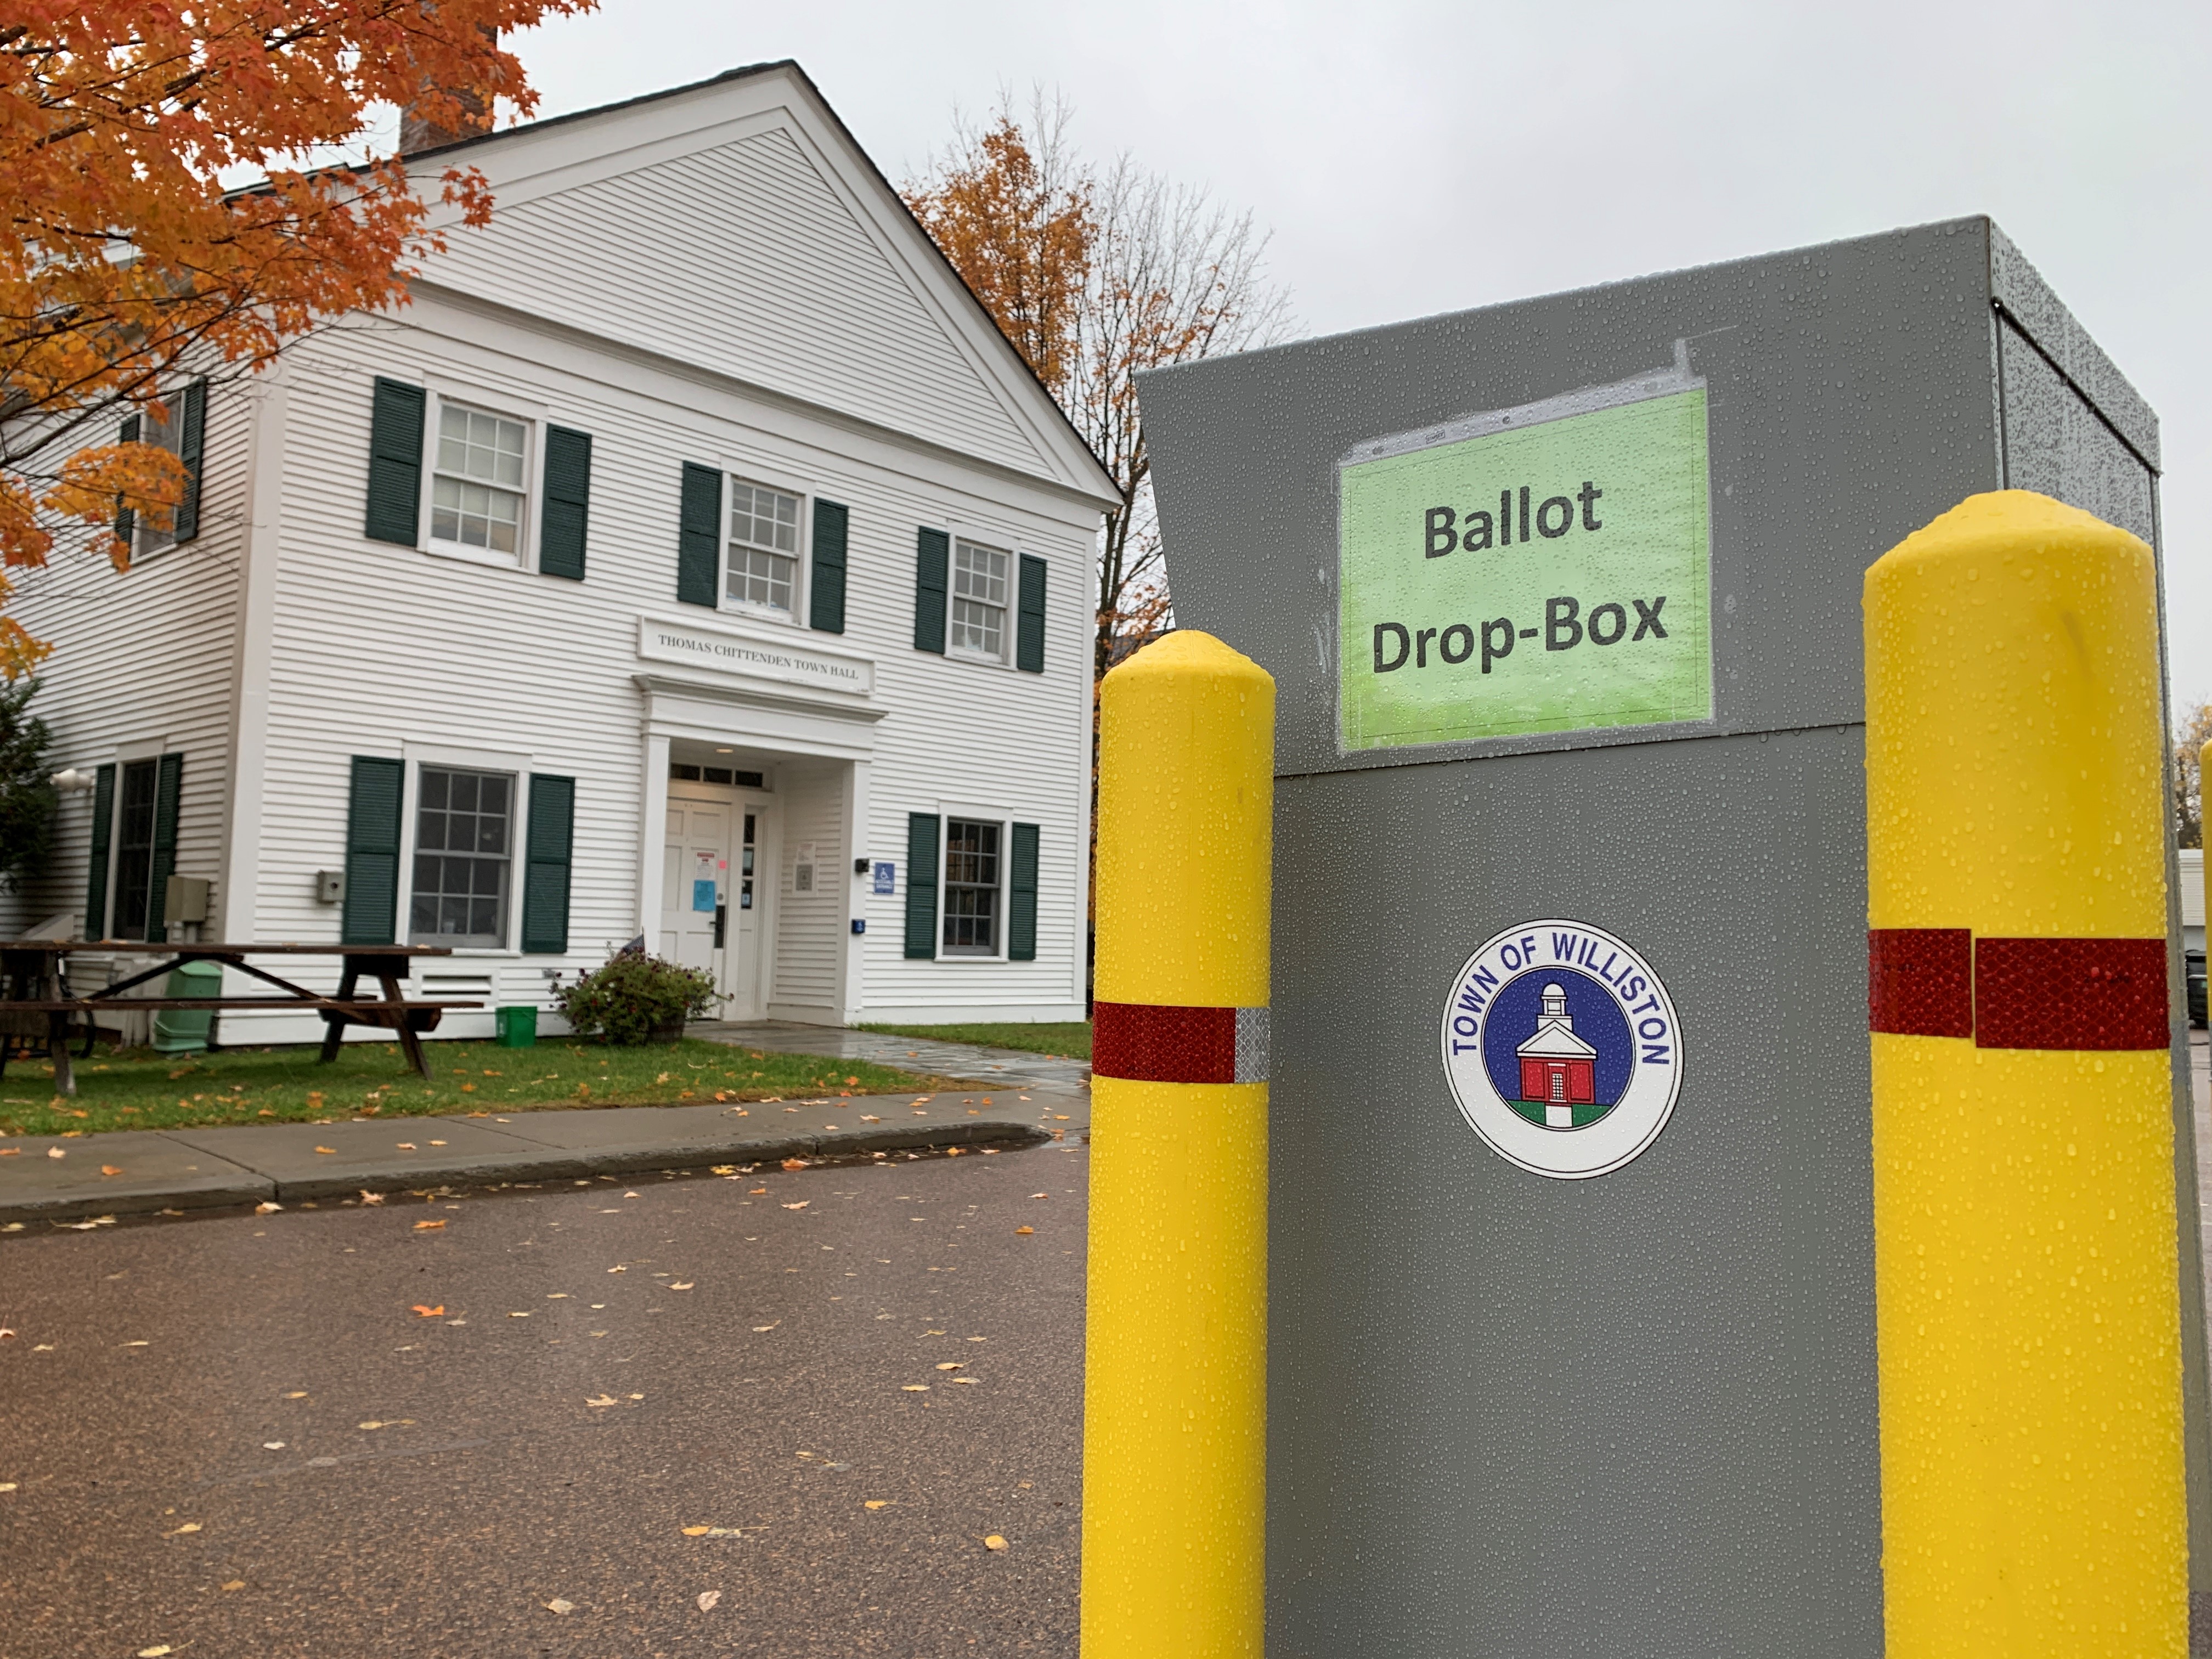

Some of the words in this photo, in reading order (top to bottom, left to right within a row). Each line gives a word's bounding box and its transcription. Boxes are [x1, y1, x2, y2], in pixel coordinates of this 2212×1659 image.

[1425, 481, 1602, 559] Ballot
[658, 634, 712, 653] THOMAS
[715, 645, 792, 667] CHITTENDEN
[794, 659, 828, 674] TOWN
[831, 665, 859, 680] HALL
[1373, 596, 1669, 674] Drop-Box
[1453, 965, 1499, 1056] TOWN
[1500, 935, 1537, 970] OF
[1552, 932, 1670, 1065] WILLISTON
